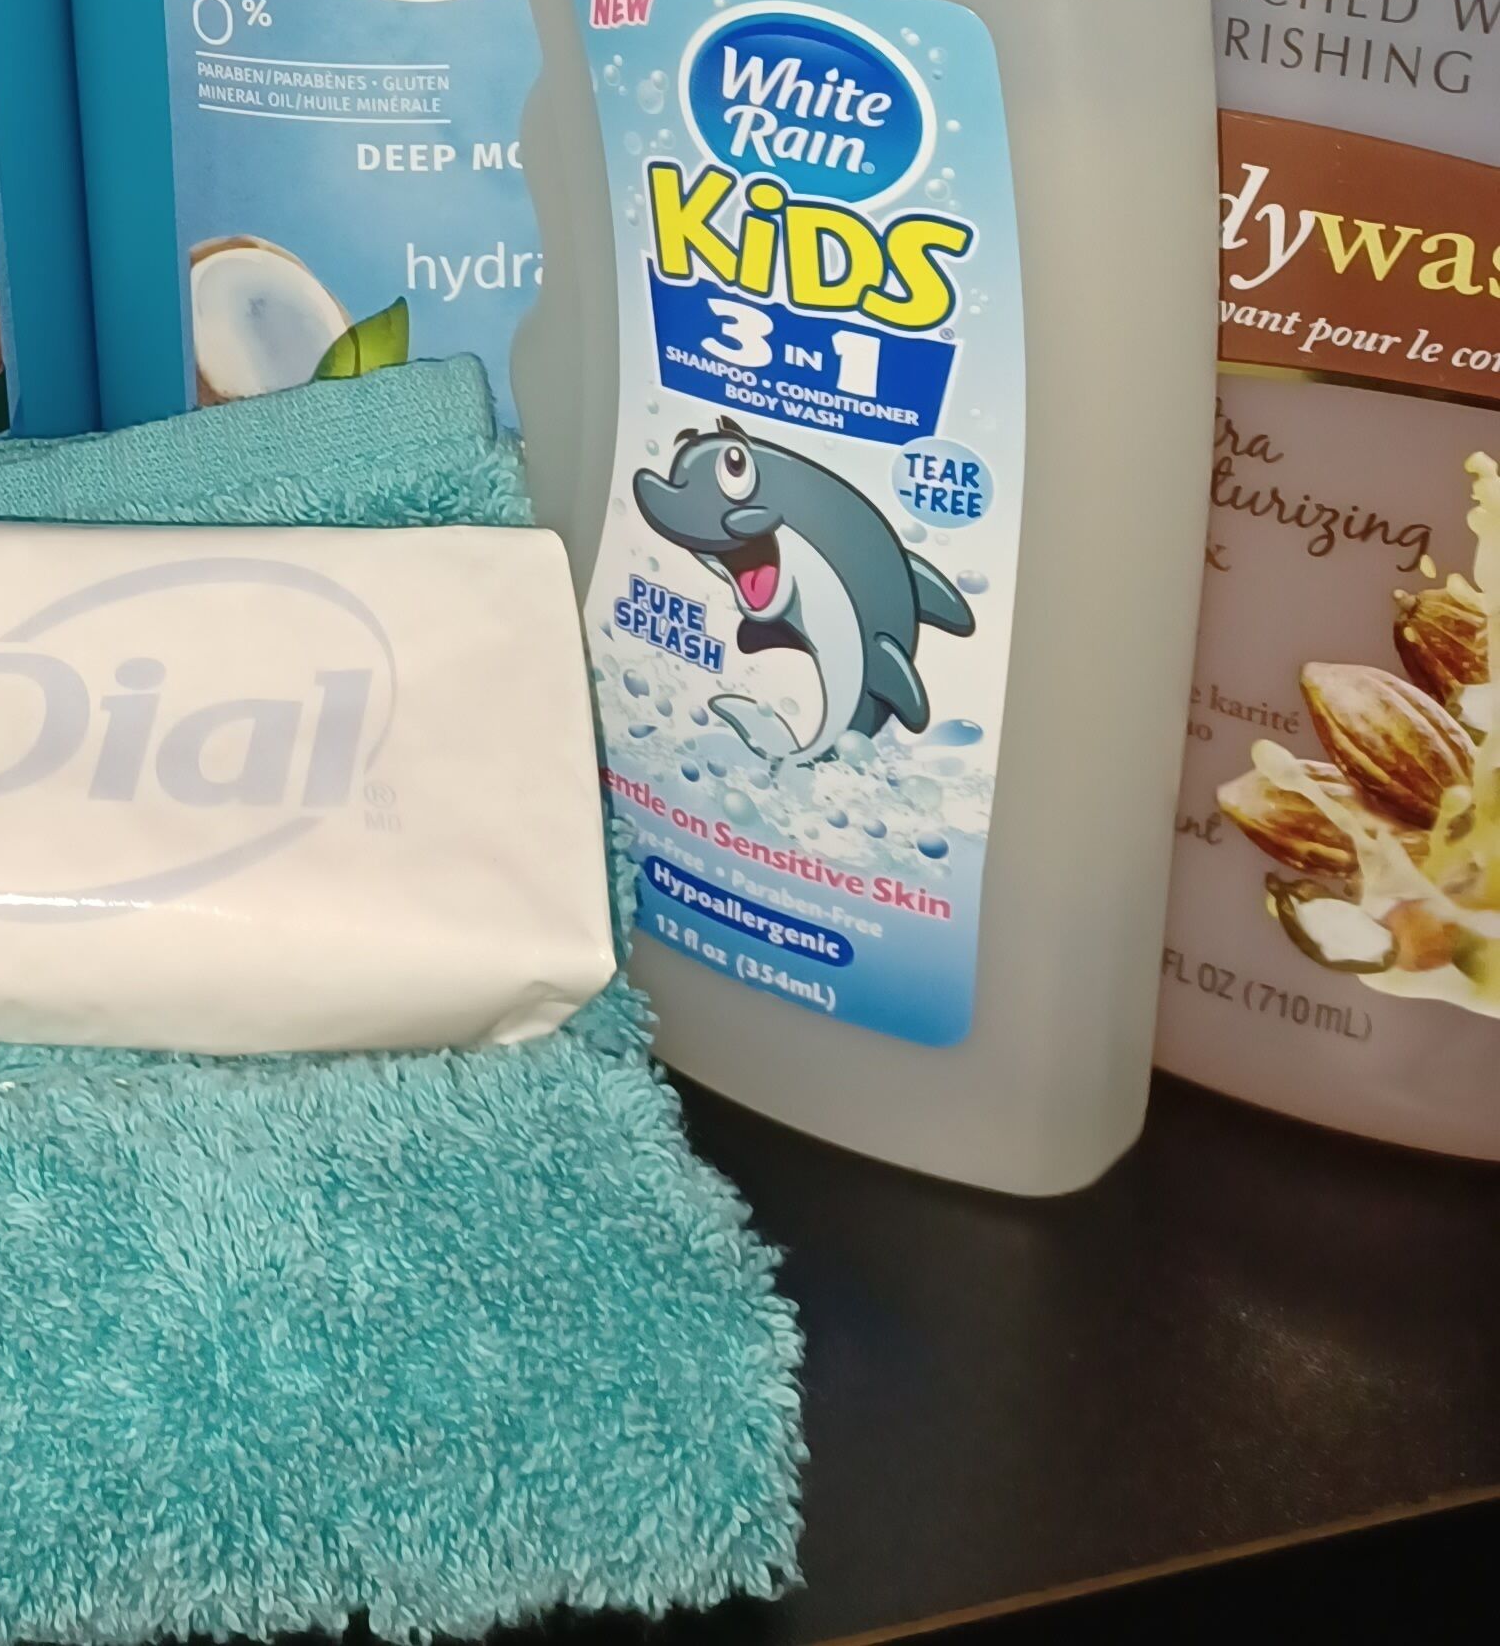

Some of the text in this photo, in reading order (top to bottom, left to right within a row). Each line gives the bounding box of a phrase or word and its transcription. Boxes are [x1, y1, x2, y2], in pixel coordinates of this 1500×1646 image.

[382, 76, 449, 91] GLUTEN
[721, 46, 892, 127] White
[1225, 17, 1473, 94] RISHING
[198, 84, 263, 105] MINERAL
[357, 143, 457, 171] DEEP
[407, 242, 543, 301] hydr
[700, 297, 881, 397] 3 IN 1
[1219, 300, 1302, 336] vant
[1298, 317, 1402, 355] pour
[1406, 328, 1444, 363] le
[666, 346, 919, 426] SHAMPOO CONDITIONER
[725, 384, 844, 429] BODY WASH
[904, 453, 980, 488] TEAR
[1210, 456, 1433, 573] turizing
[616, 603, 722, 670] SPLASH
[632, 577, 704, 631] PURE
[1209, 684, 1301, 736] karité
[600, 767, 951, 919] entle on Sensitive Skin
[653, 861, 840, 960] Hypoallergenic
[732, 868, 883, 938] Paraben-Free
[656, 913, 679, 939] 12
[703, 943, 727, 965] oz
[736, 955, 836, 1011] (354mL)
[1199, 962, 1237, 1001] OZ
